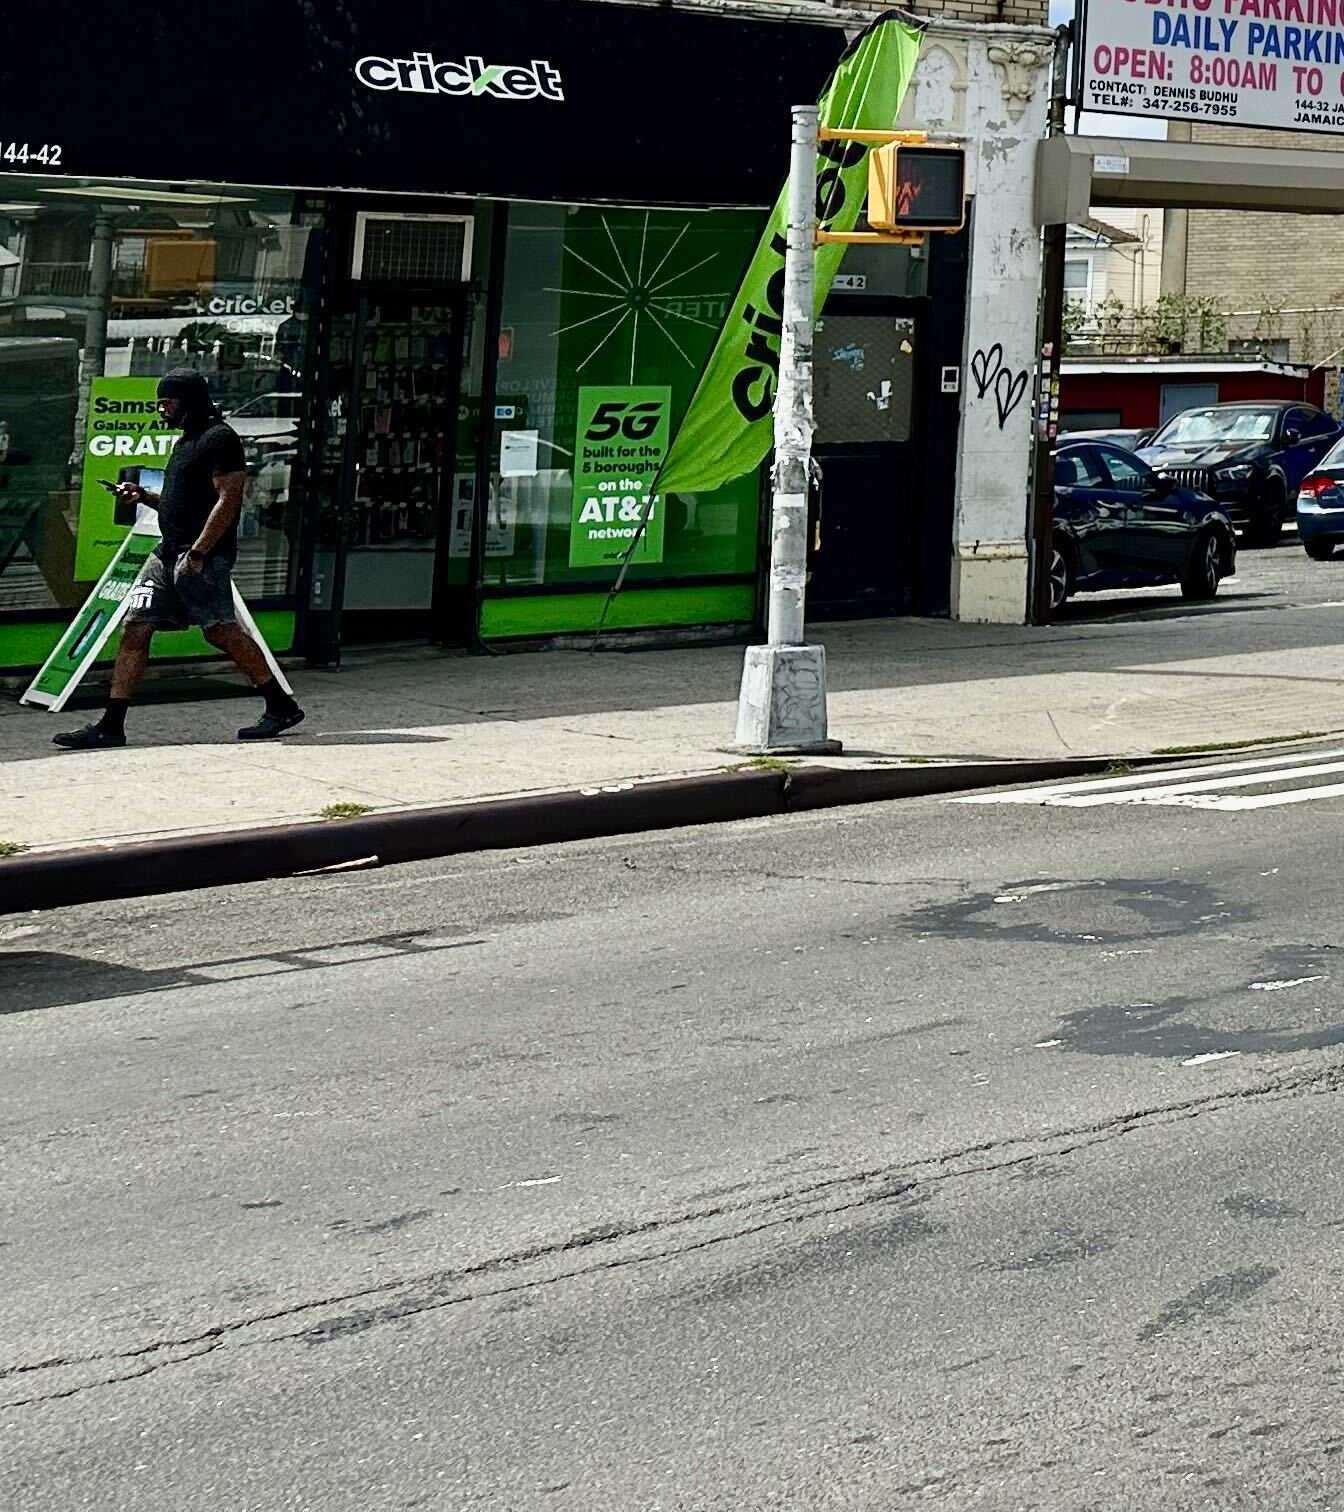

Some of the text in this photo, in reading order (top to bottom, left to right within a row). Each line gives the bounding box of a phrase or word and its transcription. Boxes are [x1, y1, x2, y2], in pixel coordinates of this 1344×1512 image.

[1152, 10, 1238, 53] DAILY
[355, 51, 566, 101] cricket
[1093, 44, 1174, 81] OPEN:
[1189, 54, 1277, 91] 8:00AM
[1292, 66, 1323, 96] TO
[1089, 79, 1238, 104] CONTACT: DENNIS BUDHU
[1092, 93, 1237, 117] TEL#: 347-256-7955
[1295, 99, 1329, 112] 144-32
[0, 141, 62, 166] 44-42
[208, 294, 296, 314] cricket
[93, 420, 147, 433] Galaxy
[584, 402, 665, 441] 5G
[582, 445, 661, 458] built for the
[582, 460, 661, 475] 5 boroughs
[598, 478, 643, 491] on the
[578, 494, 660, 523] AT&T
